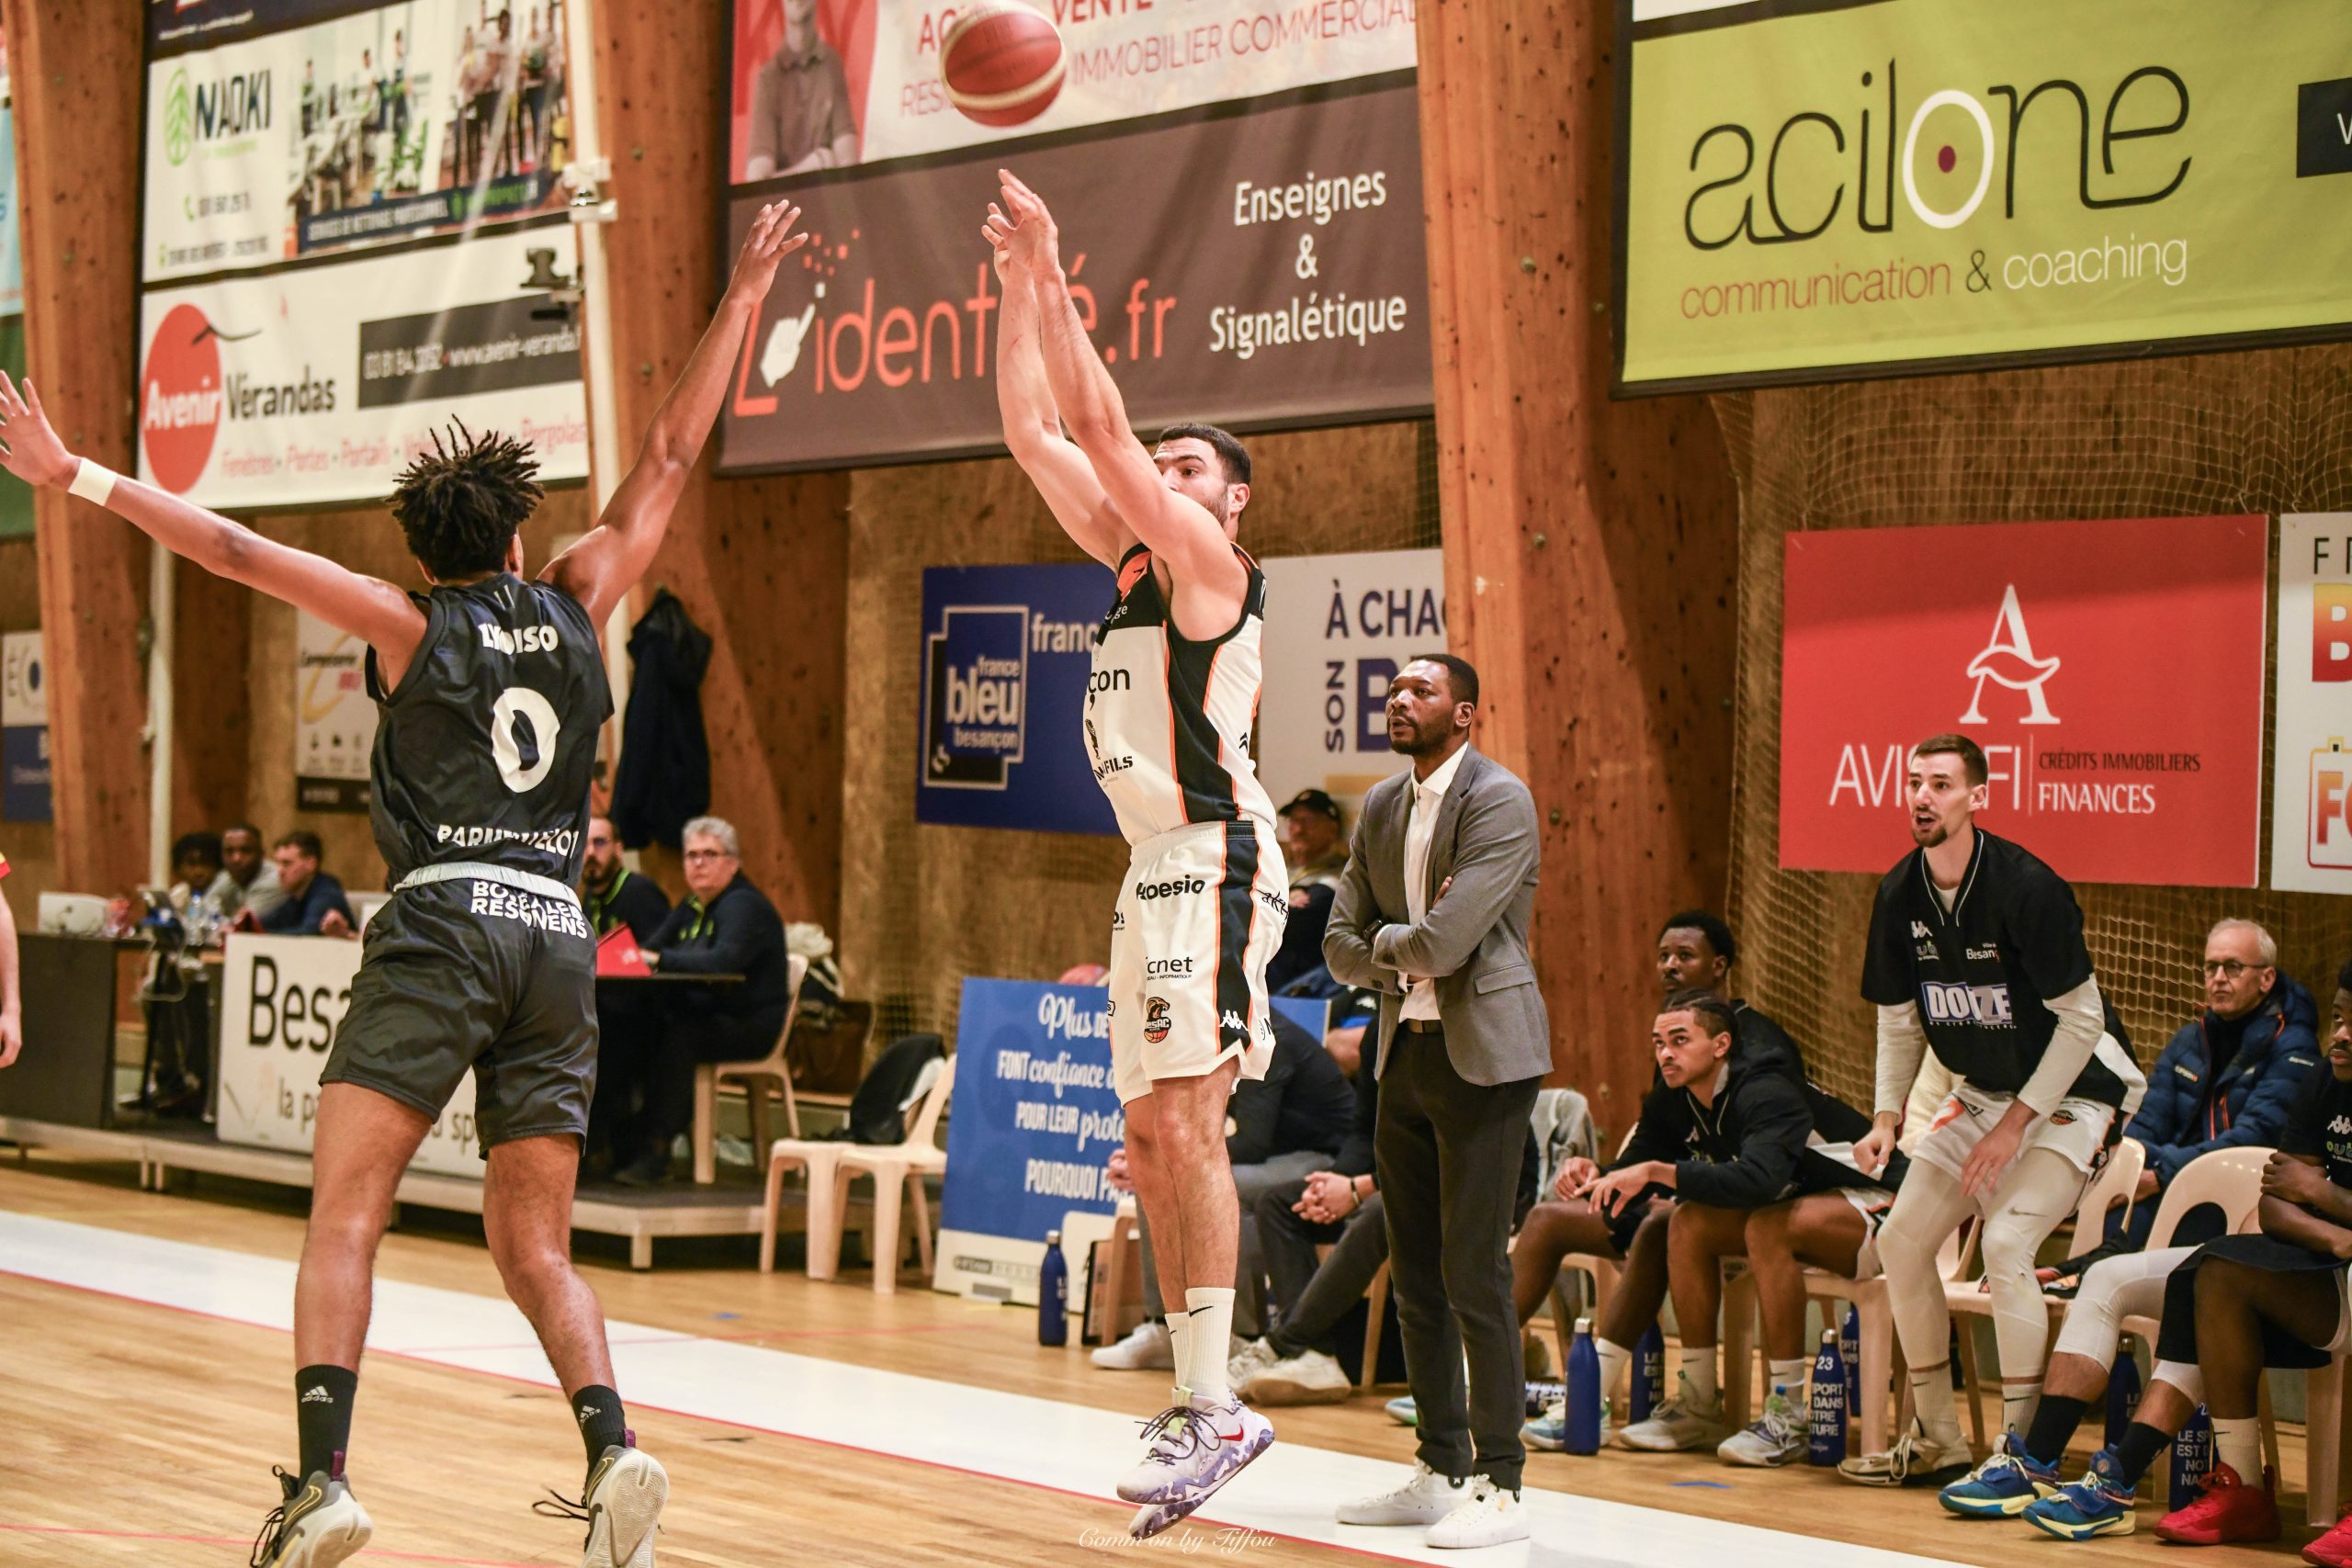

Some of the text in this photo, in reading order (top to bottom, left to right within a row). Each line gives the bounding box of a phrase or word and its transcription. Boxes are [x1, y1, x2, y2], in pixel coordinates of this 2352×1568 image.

[1071, 24, 1222, 85] IMMOBILIER
[195, 68, 272, 141] NAOKI
[1683, 57, 2192, 251] acilone
[1234, 167, 1387, 226] Enseignes
[1295, 232, 1319, 280] &
[1679, 232, 2188, 320] communication & coaching
[1208, 289, 1408, 360] Signalétique
[142, 375, 221, 432] Avenir
[1031, 612, 1099, 653] franc
[1325, 579, 1350, 638] À
[1359, 588, 1446, 638] CHA
[977, 653, 1022, 678] france
[945, 664, 1021, 726] bleu
[1326, 660, 1346, 753] SON
[491, 687, 561, 794] 0
[953, 726, 1019, 755] besançon
[2039, 746, 2098, 771] CRÉDITS
[2102, 750, 2202, 773] IMMOBILIERS
[2037, 781, 2156, 815] FINANCES
[1037, 992, 1092, 1041] Plus
[997, 1049, 1031, 1080] FONT
[1028, 1050, 1104, 1099] confiance
[1014, 1100, 1047, 1131] POUR
[1047, 1104, 1080, 1134] LEUR
[1023, 1157, 1099, 1198] POURQUOI
[1815, 1354, 1835, 1371] 23
